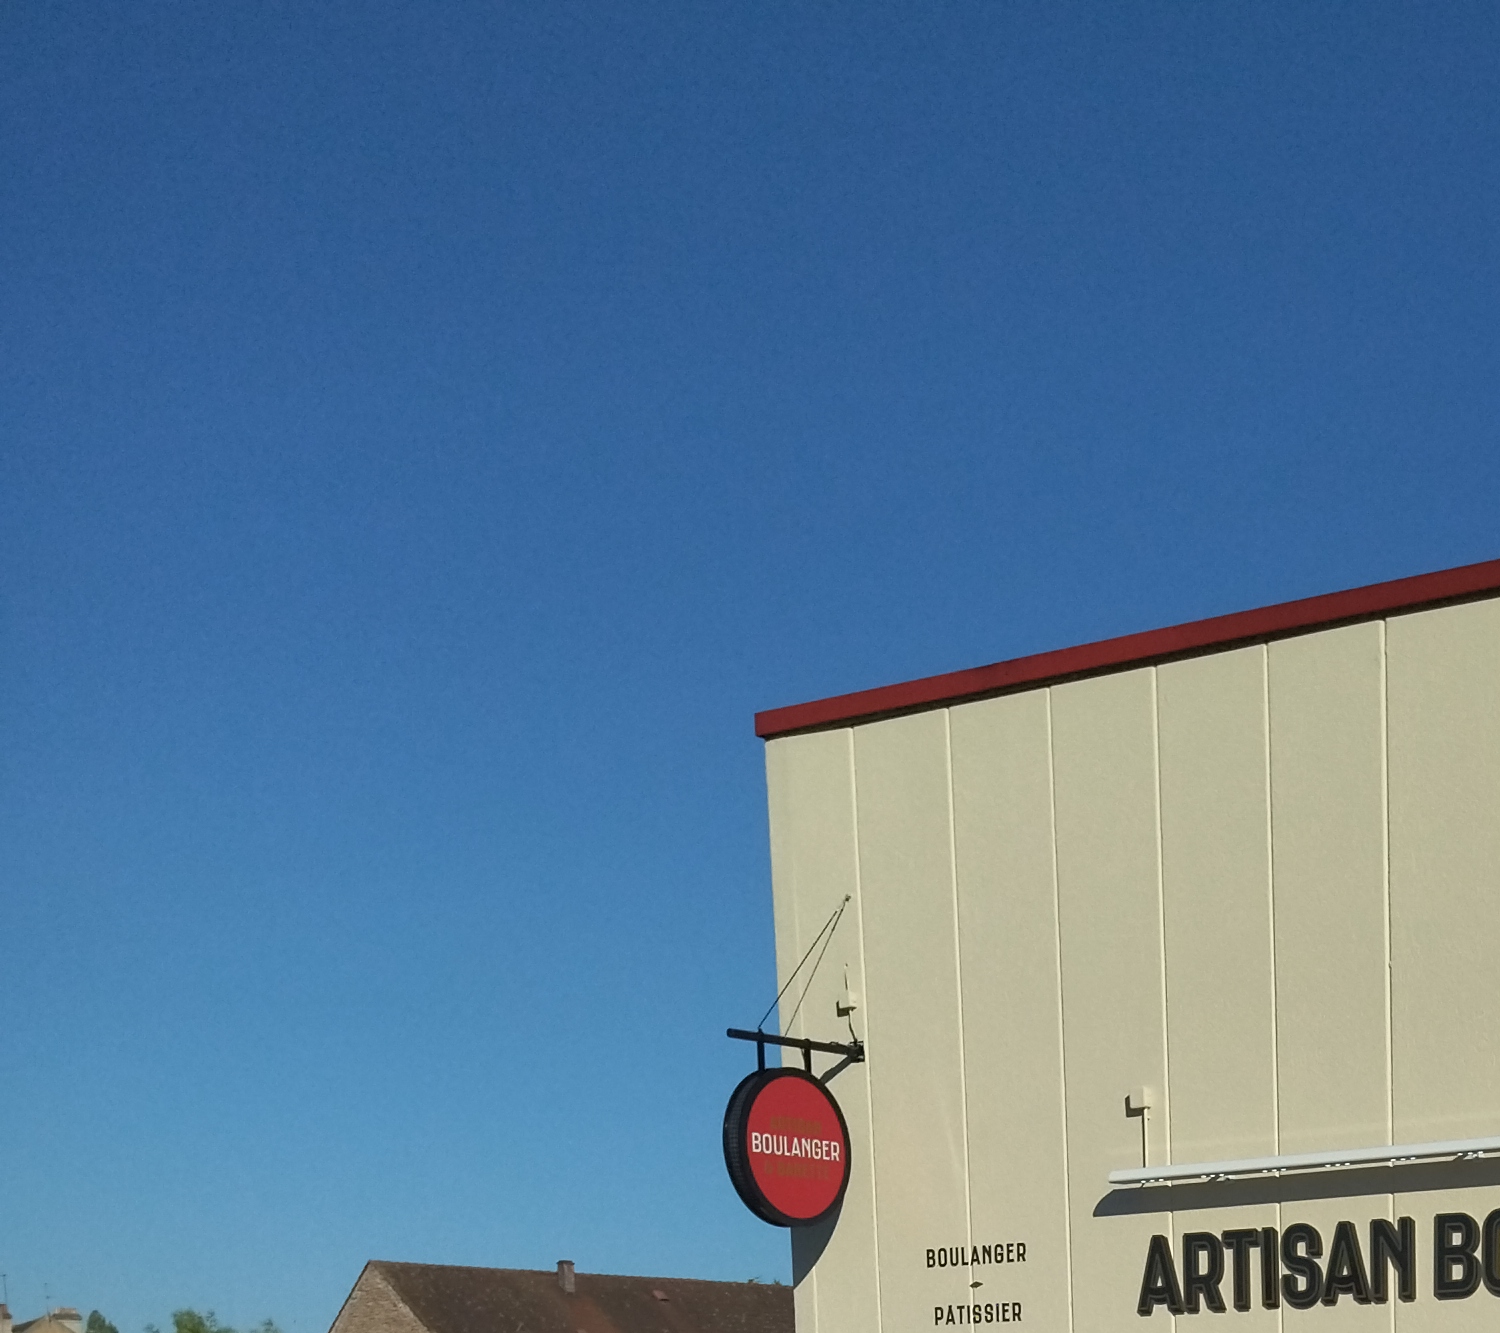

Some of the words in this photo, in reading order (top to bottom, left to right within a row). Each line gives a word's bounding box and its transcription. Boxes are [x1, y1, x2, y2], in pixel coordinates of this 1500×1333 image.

[751, 1132, 840, 1161] BOULANGER
[926, 1243, 1026, 1268] BOULANGER
[1137, 1216, 1416, 1317] ARTISAN
